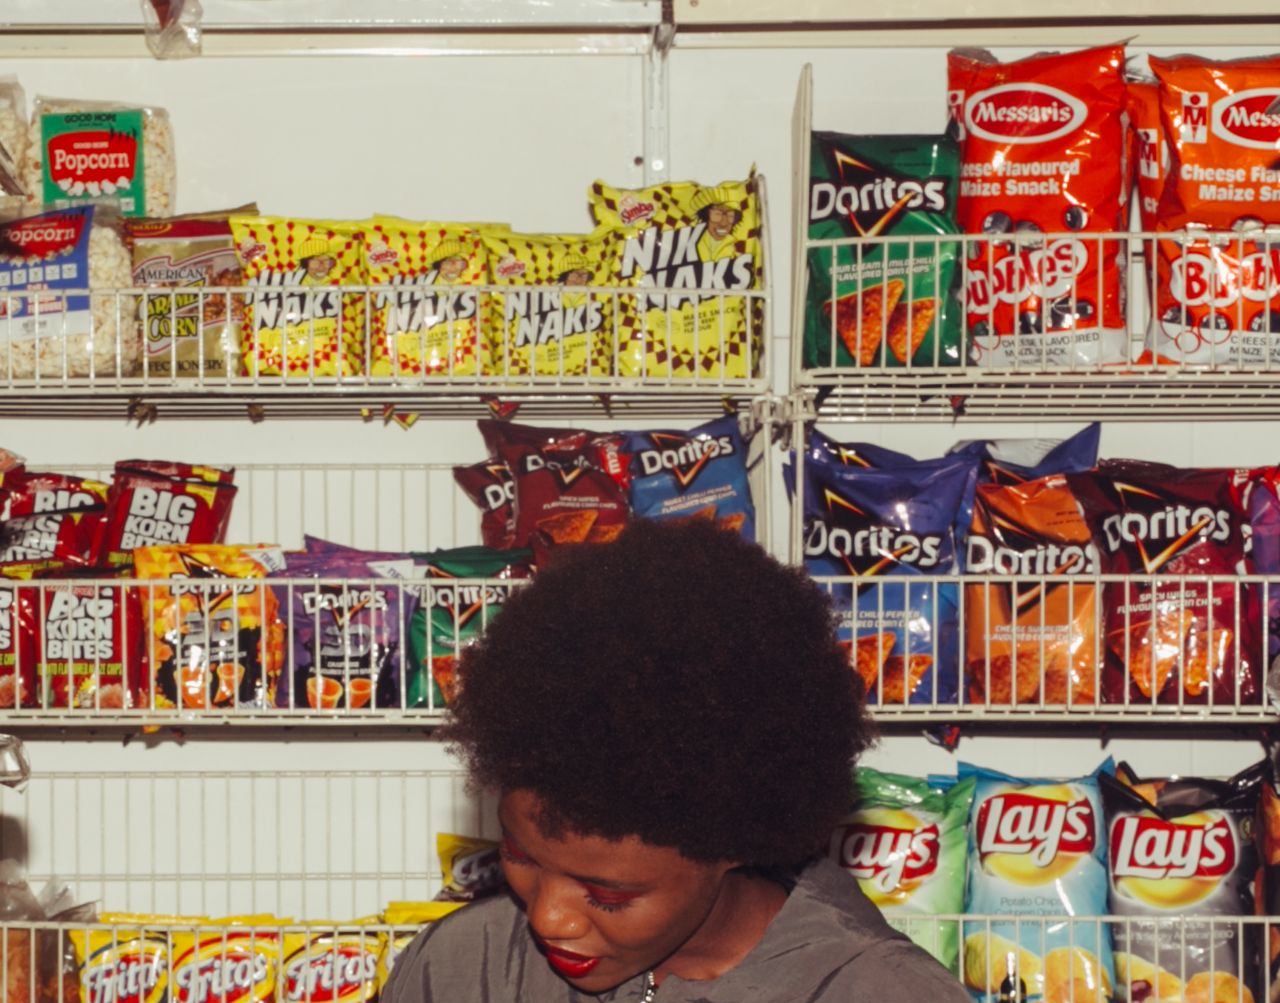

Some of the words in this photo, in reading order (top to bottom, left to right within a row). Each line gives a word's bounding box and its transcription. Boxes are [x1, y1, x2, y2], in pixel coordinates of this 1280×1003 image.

[65, 114, 90, 124] GOOD
[94, 113, 117, 123] HOPE
[974, 100, 1072, 124] Messaris
[54, 149, 130, 175] Popcorn
[998, 159, 1080, 177] Flavoured
[1181, 164, 1246, 182] Cheese
[811, 177, 946, 220] Doritos
[1005, 178, 1060, 196] Snack
[1199, 185, 1255, 201] Maize
[620, 201, 655, 224] Simba
[2, 226, 76, 246] Popcorn
[621, 223, 707, 278] NIK
[136, 267, 205, 285] AMERICAN
[637, 253, 754, 312] NAKS
[966, 242, 1080, 309] ubbles
[147, 317, 199, 342] CORN
[516, 301, 604, 347] NAKS
[641, 436, 734, 476] Doritos
[129, 486, 198, 525] BIG
[124, 515, 190, 544] KORN
[1103, 504, 1231, 553] Doritos
[804, 520, 942, 567] Doritos
[966, 535, 1100, 576] Doritos
[47, 586, 115, 622] BIG
[303, 590, 387, 615] Doritos
[418, 584, 507, 608] Doritos
[47, 617, 114, 641] KORN
[47, 639, 114, 660] BITES
[980, 796, 1096, 868] Lay's
[1114, 816, 1231, 880] Lay's
[1000, 897, 1032, 907] Potato
[286, 951, 377, 1003] Fritos
